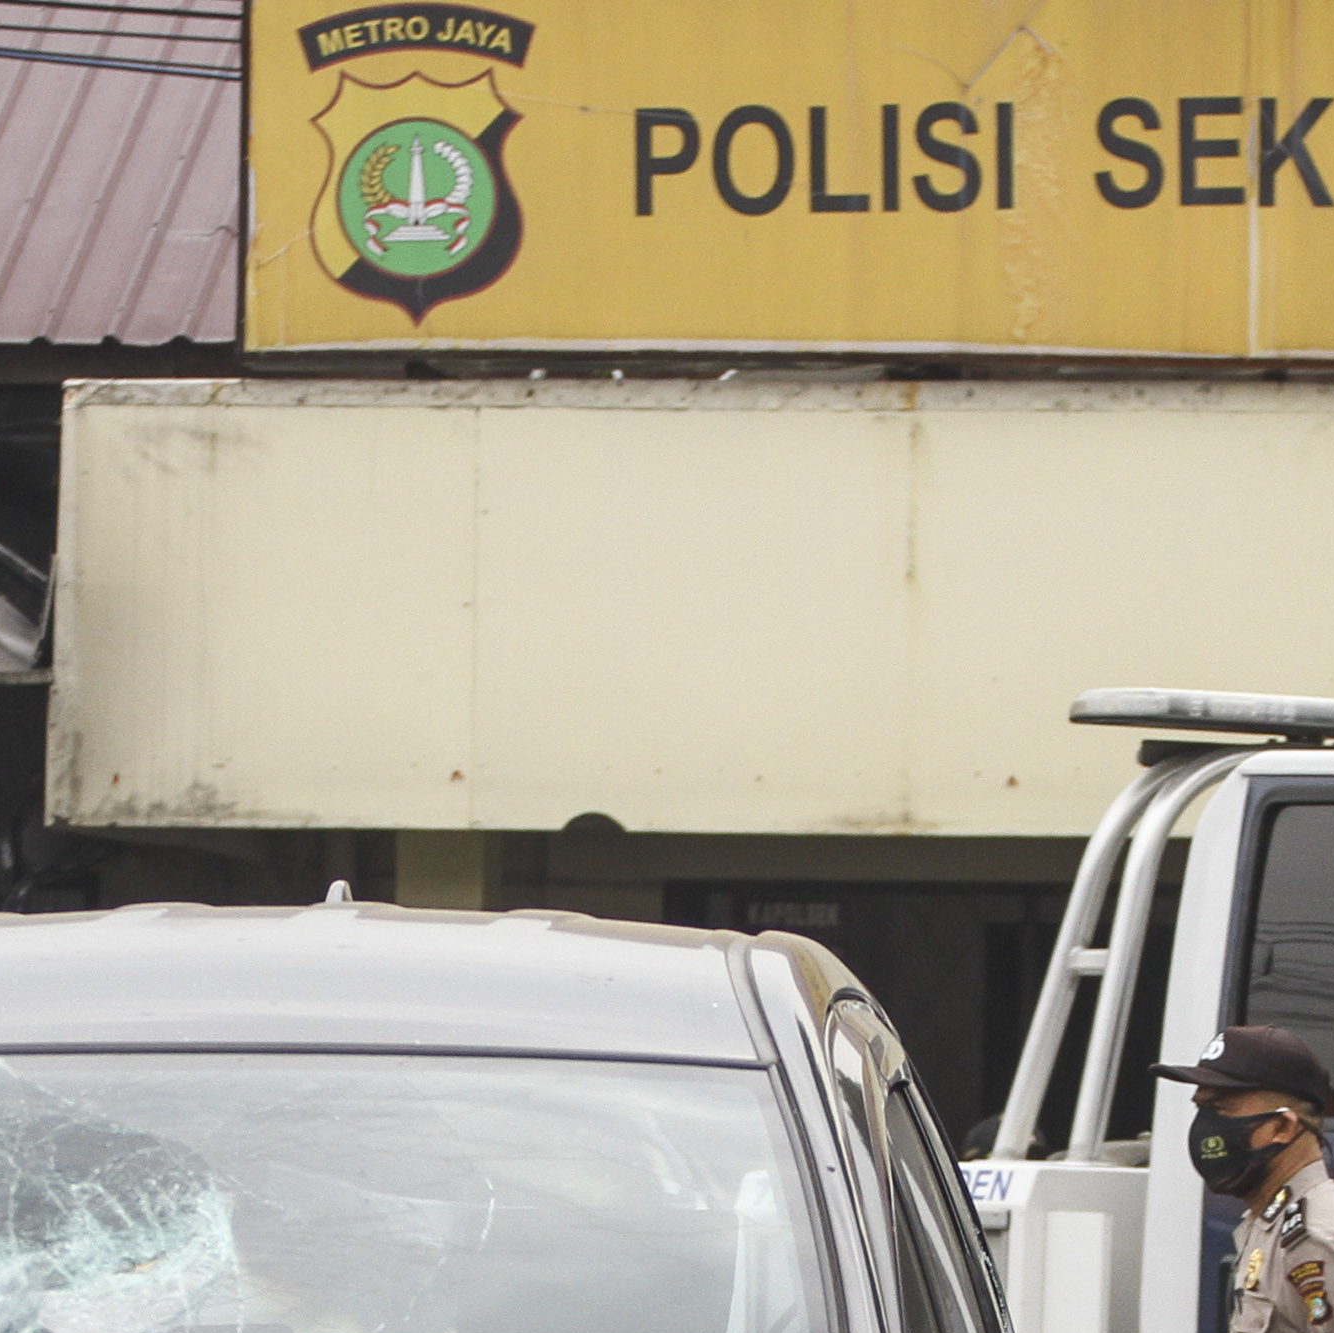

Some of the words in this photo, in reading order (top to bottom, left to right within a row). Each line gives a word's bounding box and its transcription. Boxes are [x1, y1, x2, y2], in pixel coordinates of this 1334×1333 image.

[316, 16, 430, 57] METRO
[436, 17, 513, 54] JAYA
[633, 100, 1015, 217] POLISI
